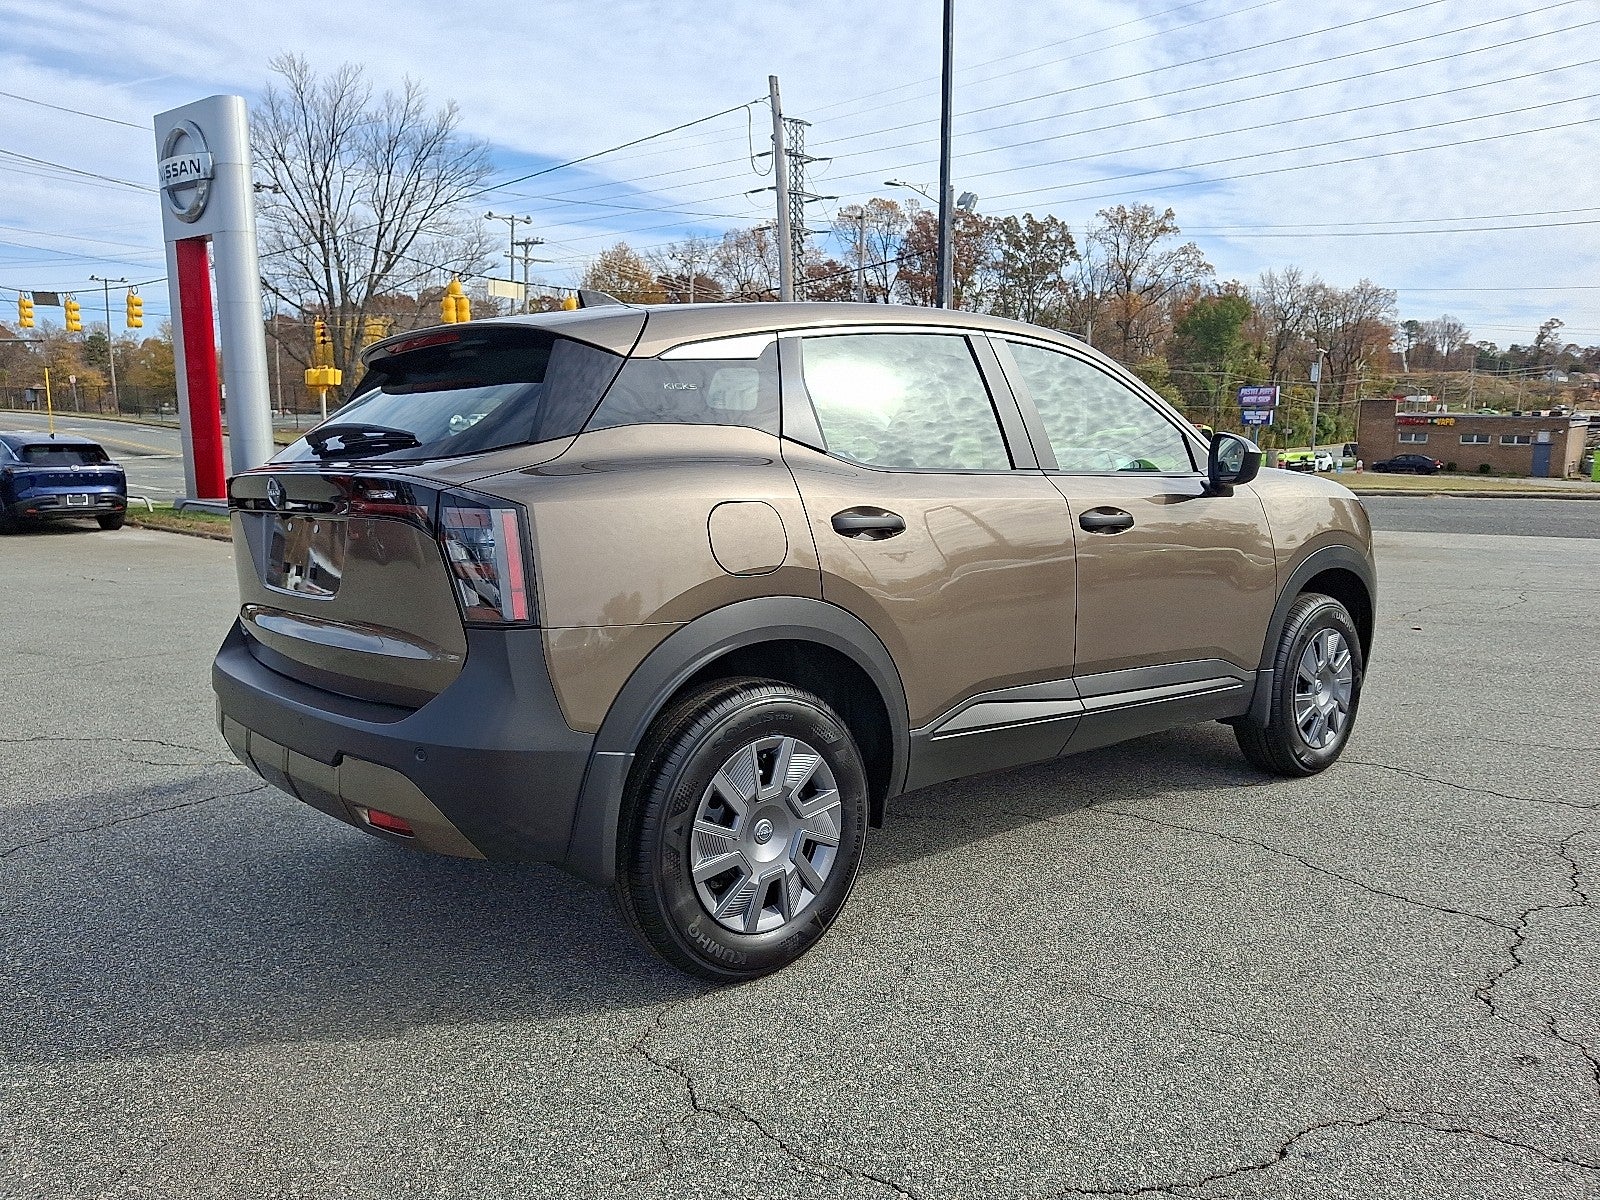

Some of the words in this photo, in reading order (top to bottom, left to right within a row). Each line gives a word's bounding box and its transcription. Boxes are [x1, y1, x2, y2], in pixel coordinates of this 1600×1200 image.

[663, 382, 698, 390] KICKS
[1436, 417, 1456, 426] VAPE
[688, 922, 747, 965] KUMHO
